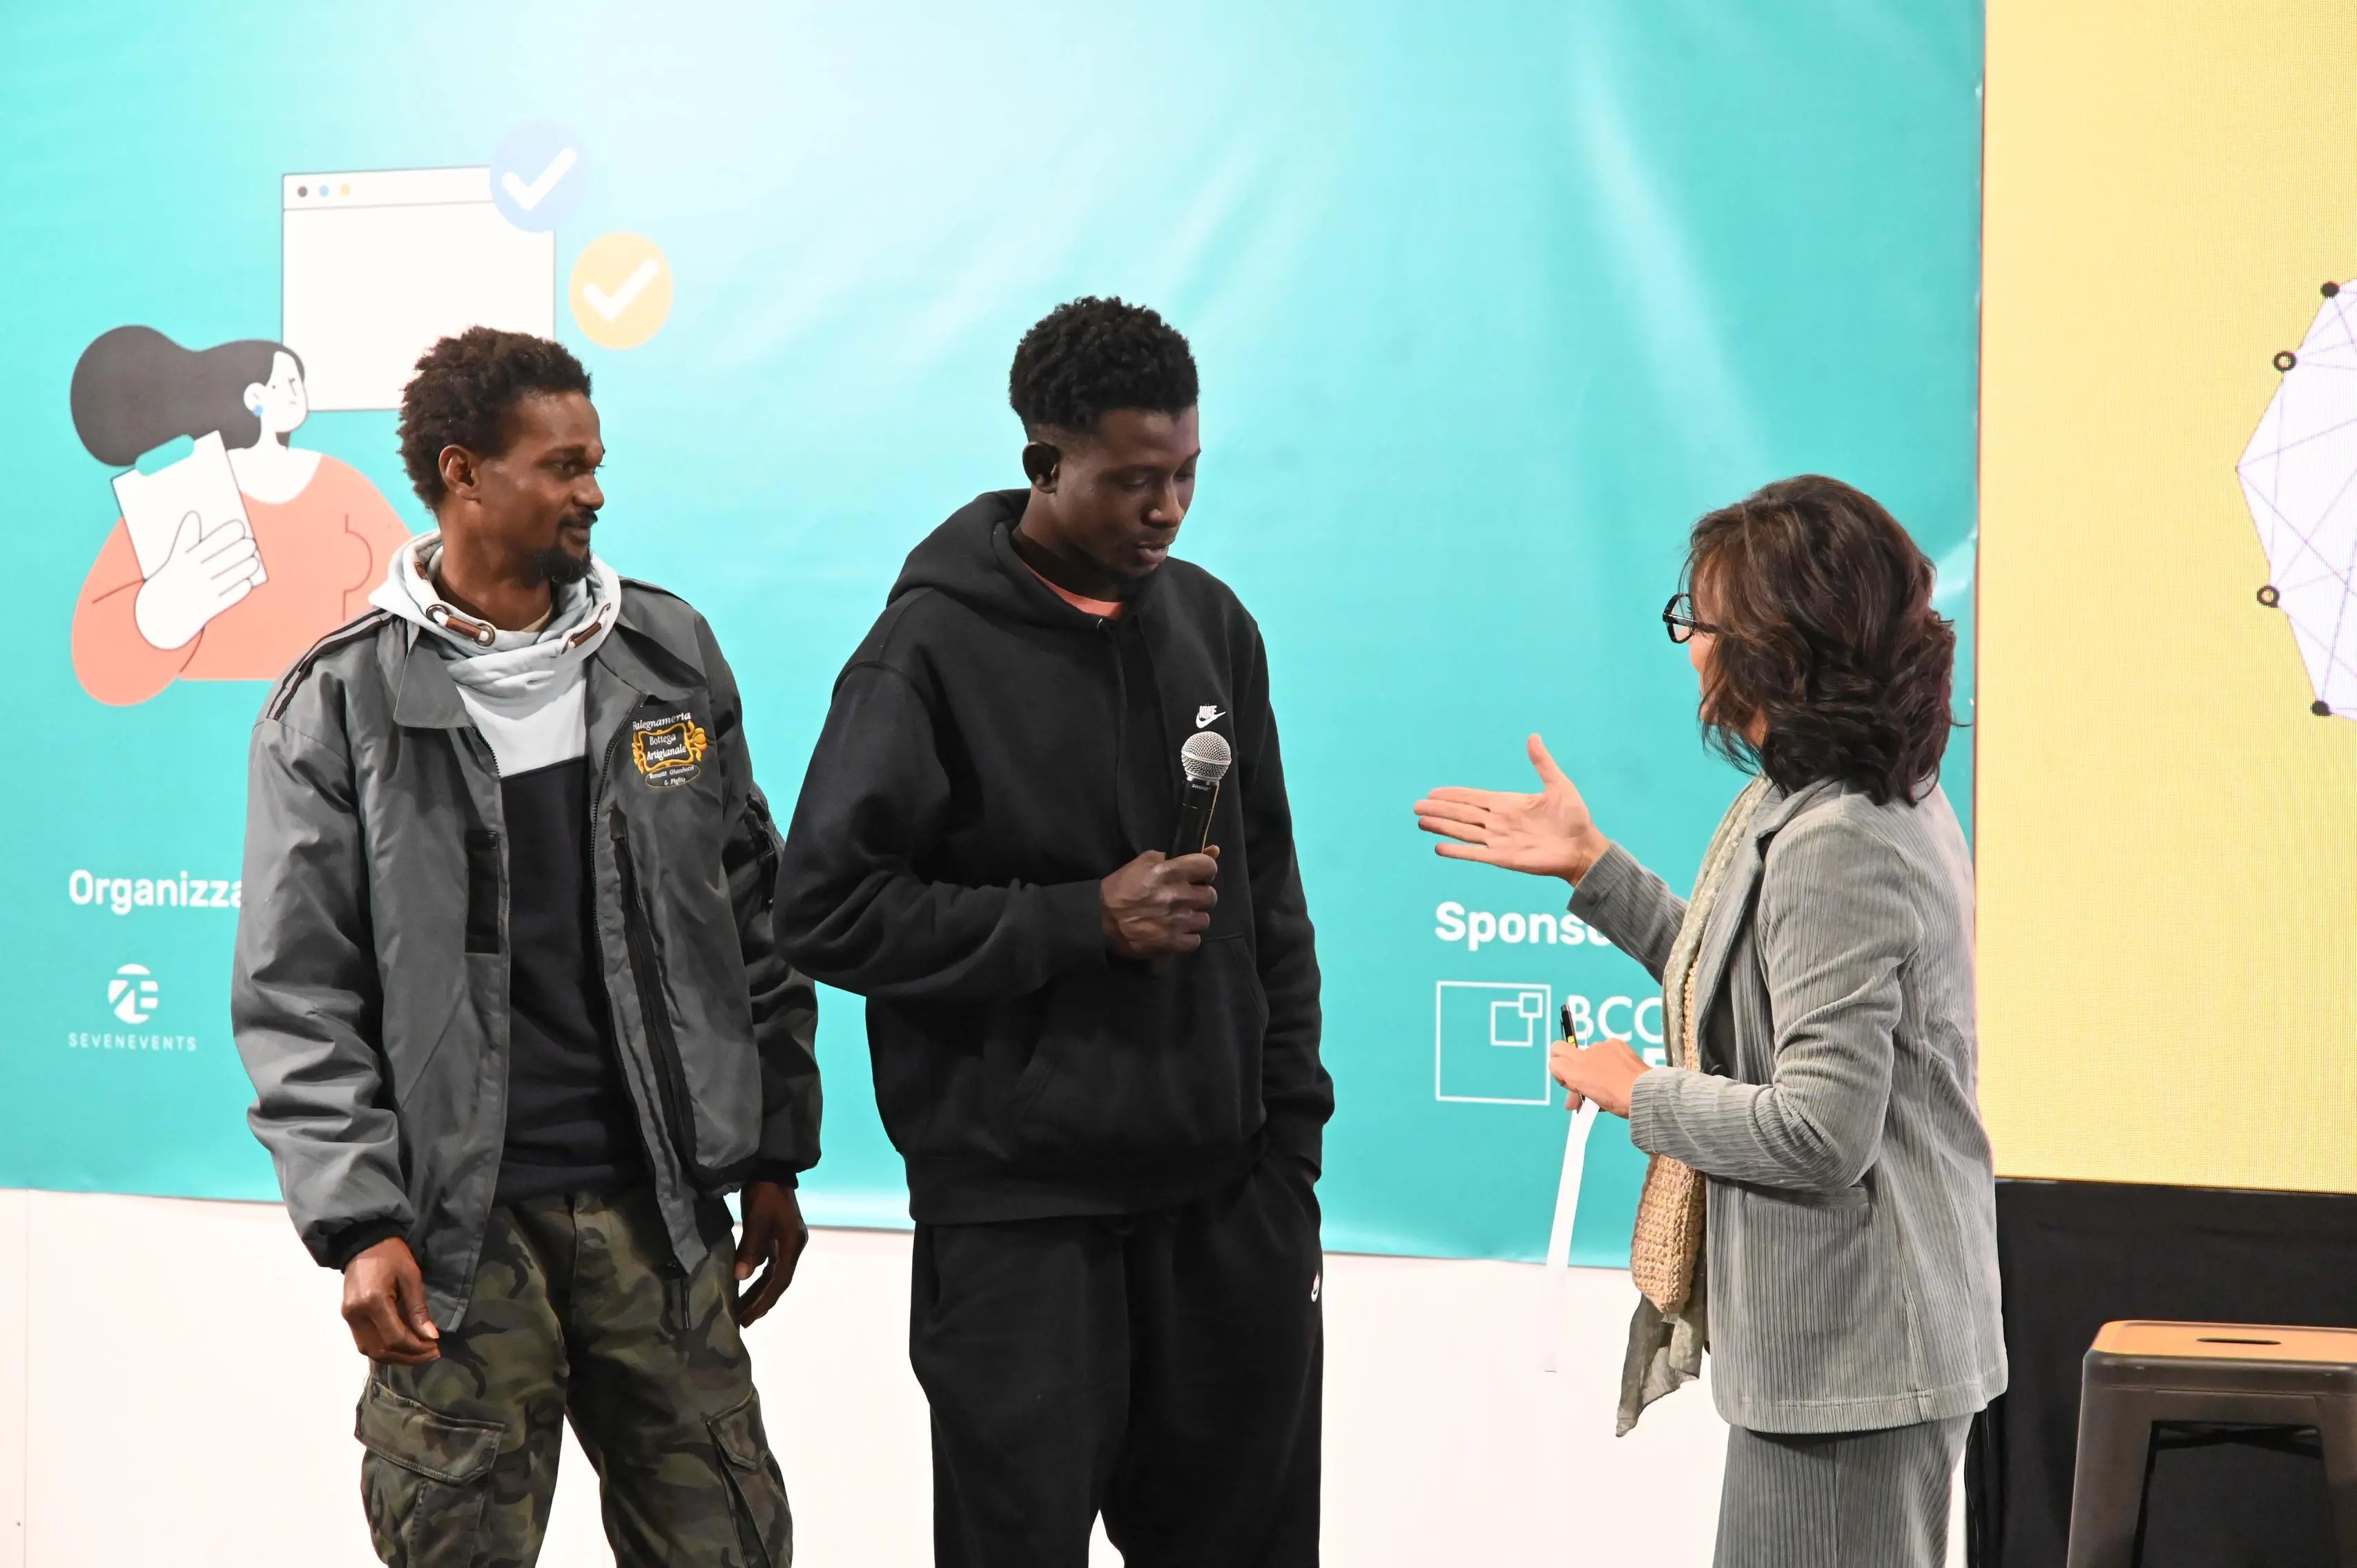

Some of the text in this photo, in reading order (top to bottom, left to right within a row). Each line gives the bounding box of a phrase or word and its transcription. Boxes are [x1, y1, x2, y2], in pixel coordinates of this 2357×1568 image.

[1199, 704, 1217, 719] NIKE
[649, 733, 677, 745] Bottega
[647, 743, 686, 761] Artigianale
[1567, 994, 1663, 1044] BCC
[68, 1032, 197, 1052] SEVENEVENTS
